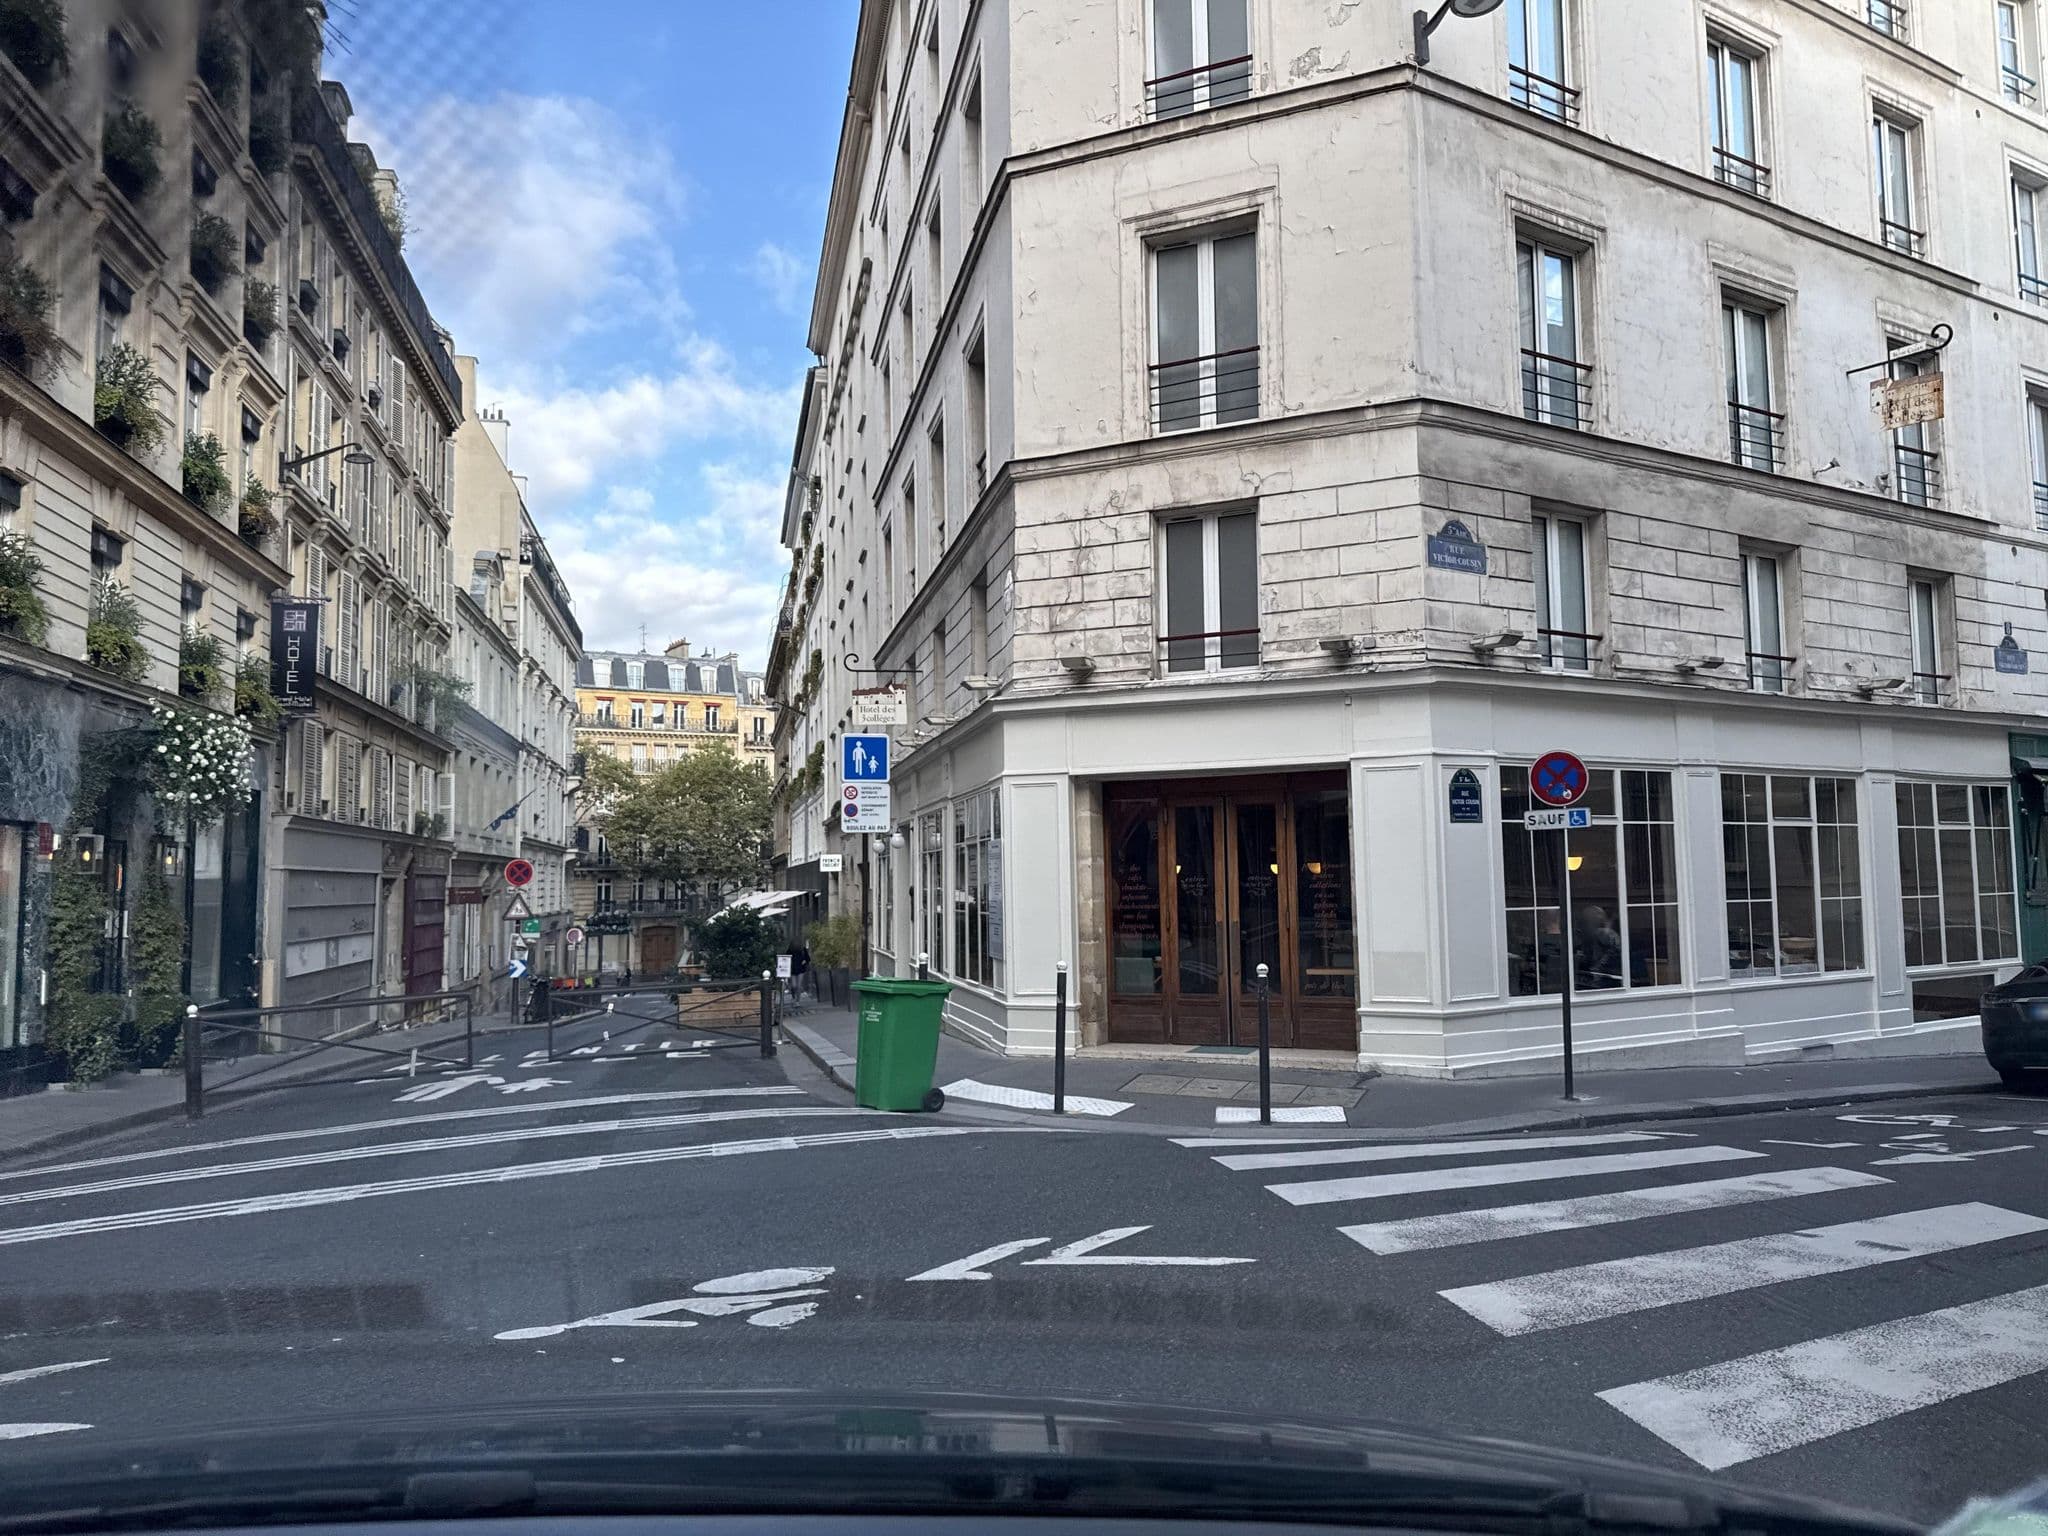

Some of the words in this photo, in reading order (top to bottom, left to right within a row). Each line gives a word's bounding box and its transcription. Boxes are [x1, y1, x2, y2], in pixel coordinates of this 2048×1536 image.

[1914, 397, 1932, 407] des
[1449, 544, 1465, 555] RUE
[881, 705, 896, 713] des
[1527, 813, 1565, 826] SAUF
